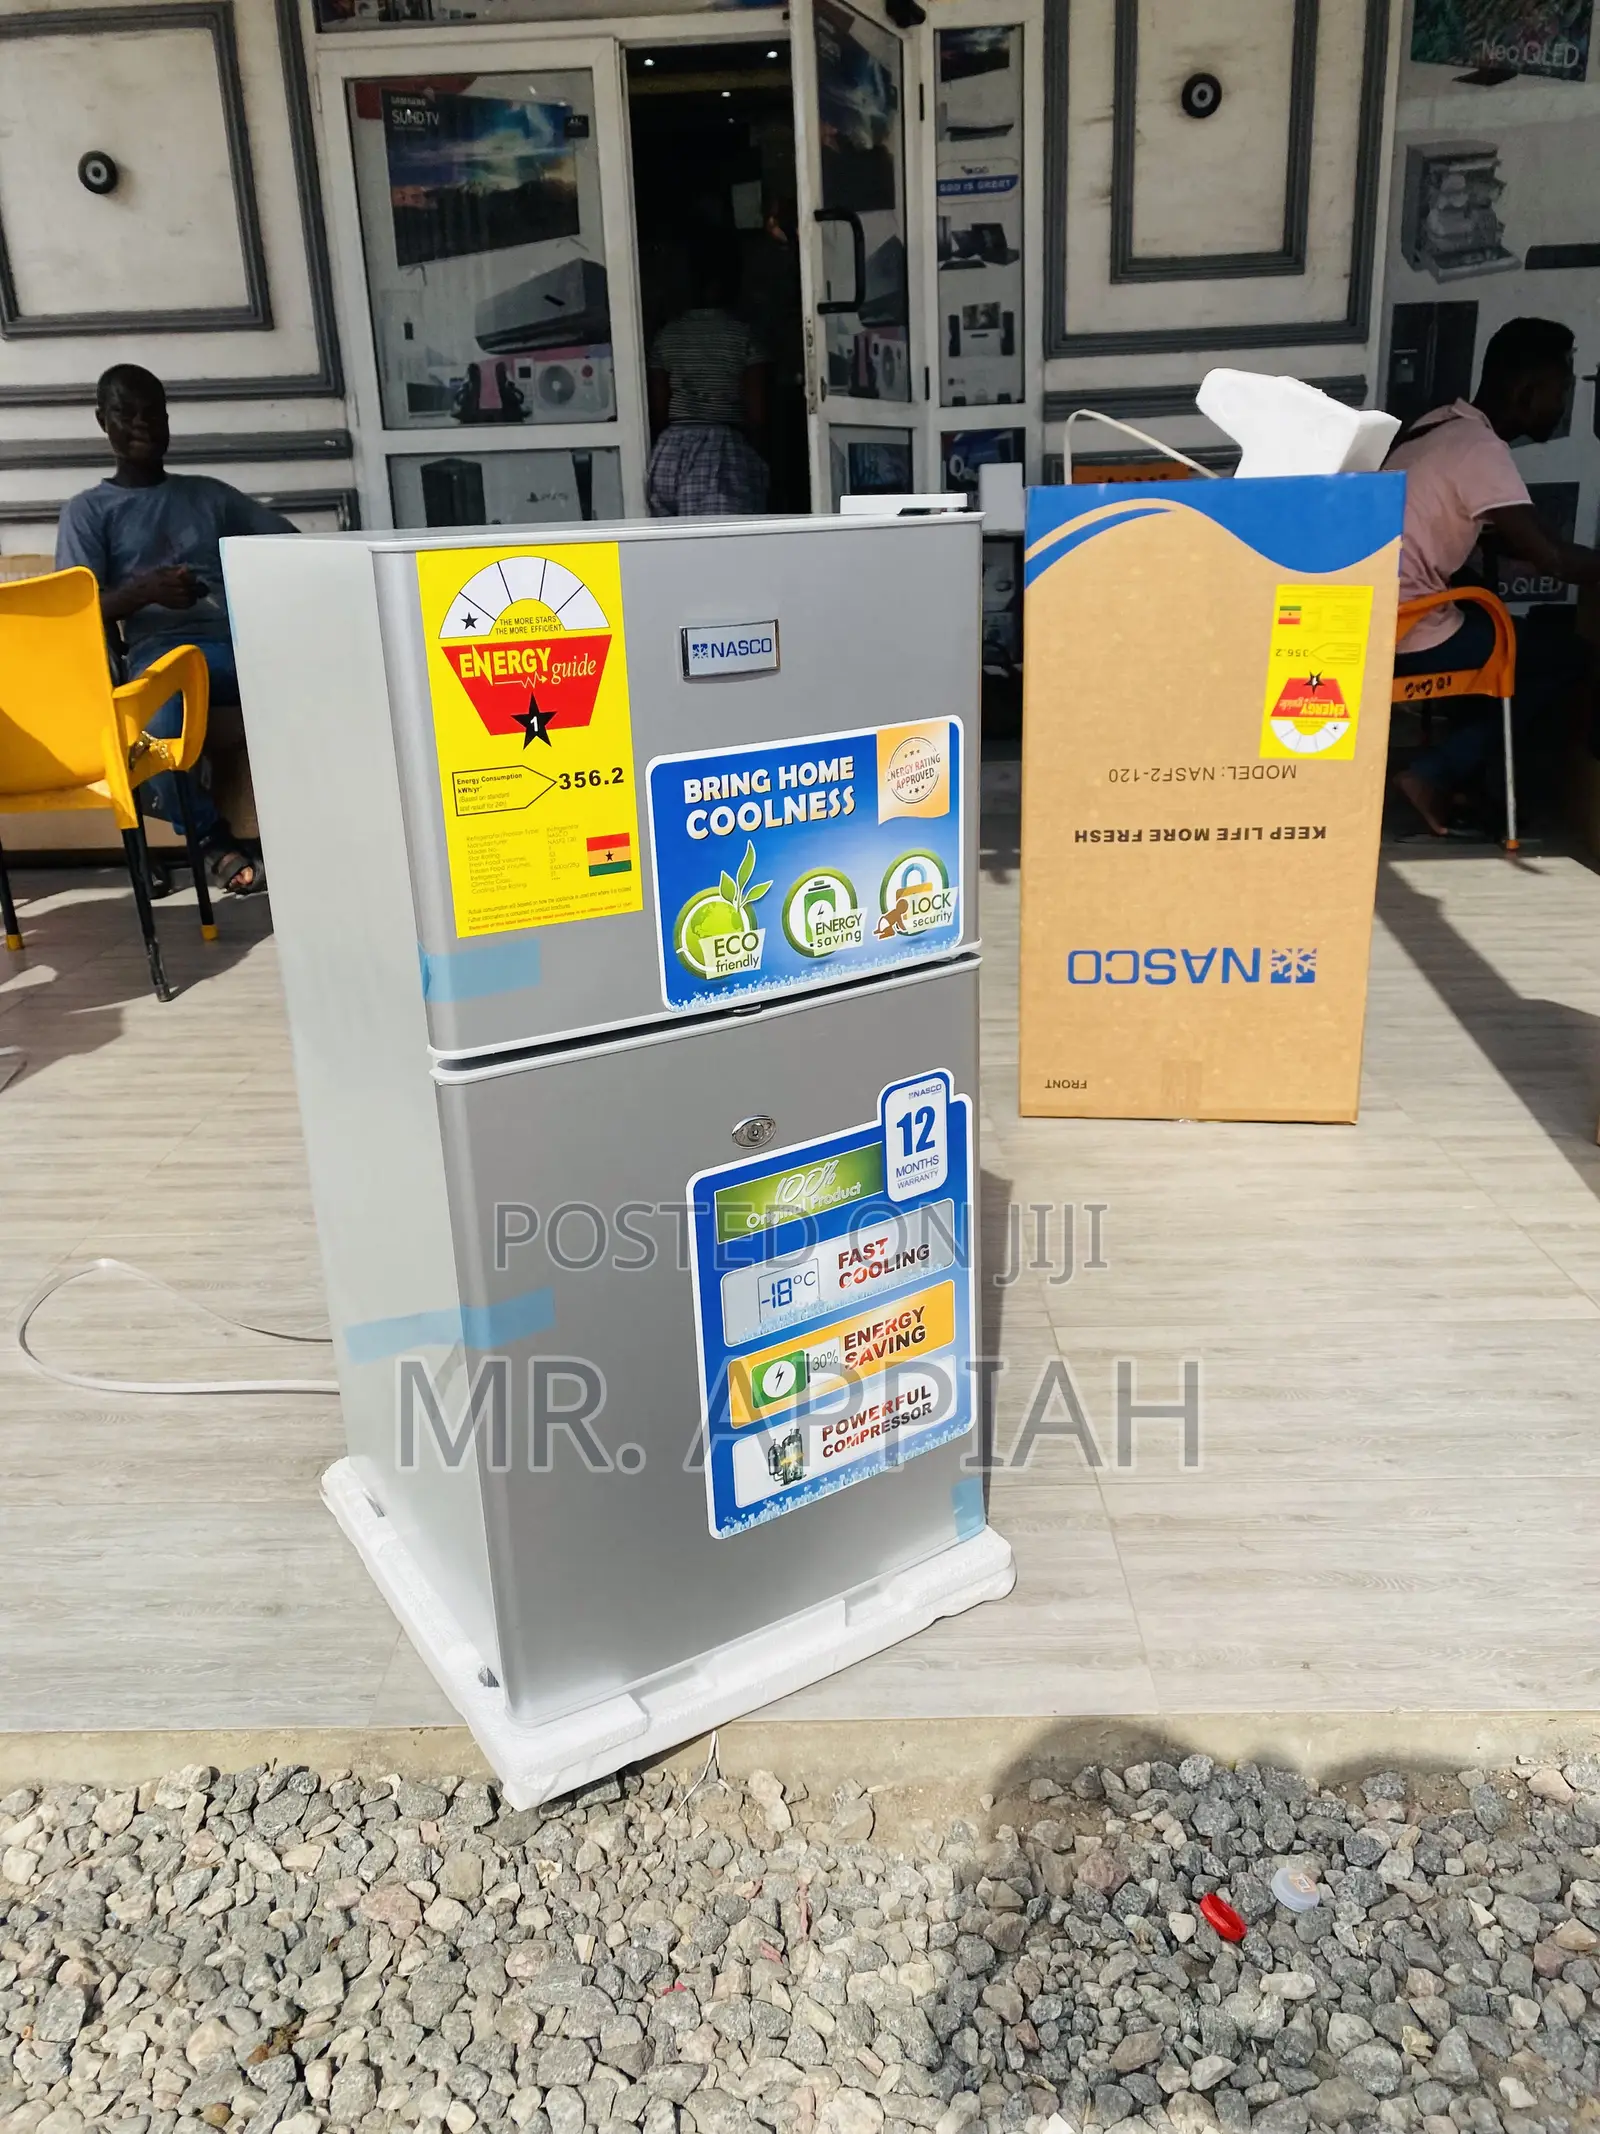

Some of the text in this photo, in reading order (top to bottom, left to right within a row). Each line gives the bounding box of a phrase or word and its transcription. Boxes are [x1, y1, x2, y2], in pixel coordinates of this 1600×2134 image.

[1482, 40, 1580, 68] Neo QLED
[495, 623, 562, 636] THE MORE EFFICIENT
[500, 615, 557, 626] THE MORE STARS
[711, 637, 772, 658] NASCO
[459, 644, 597, 686] ENERGY guide
[530, 716, 539, 732] 1
[915, 753, 941, 771] RATING
[1108, 764, 1297, 783] MODEL: NASF2-120
[456, 773, 523, 786] Energy Consumption
[558, 766, 625, 791] 356.2
[683, 756, 855, 804] BRING HOME
[896, 767, 935, 790] APPROVED
[685, 786, 856, 841] COOLNESS
[1074, 826, 1327, 843] KEEP LIFE MORE FRESH
[911, 892, 952, 915] LOCK
[815, 913, 862, 933] ENERGY
[912, 911, 953, 928] security
[714, 933, 759, 958] ECO
[816, 928, 862, 948] saving
[715, 955, 760, 973] friendly
[1067, 947, 1261, 985] NASCO
[913, 1084, 942, 1098] NASCO
[1044, 1079, 1087, 1090] FRONT
[896, 1106, 936, 1157] 12
[896, 1155, 939, 1178] MONTHS
[775, 1159, 840, 1206] 100%
[897, 1169, 939, 1189] WARRANTY
[746, 1181, 862, 1229] Original Product
[838, 1237, 889, 1270] FAST
[838, 1243, 930, 1289] COOLING
[843, 1305, 926, 1351] ENERGY
[844, 1324, 926, 1371] SAVING
[812, 1349, 839, 1373] 30%
[821, 1385, 931, 1442] POWERFUL
[822, 1402, 933, 1459] COMPRESSOR
